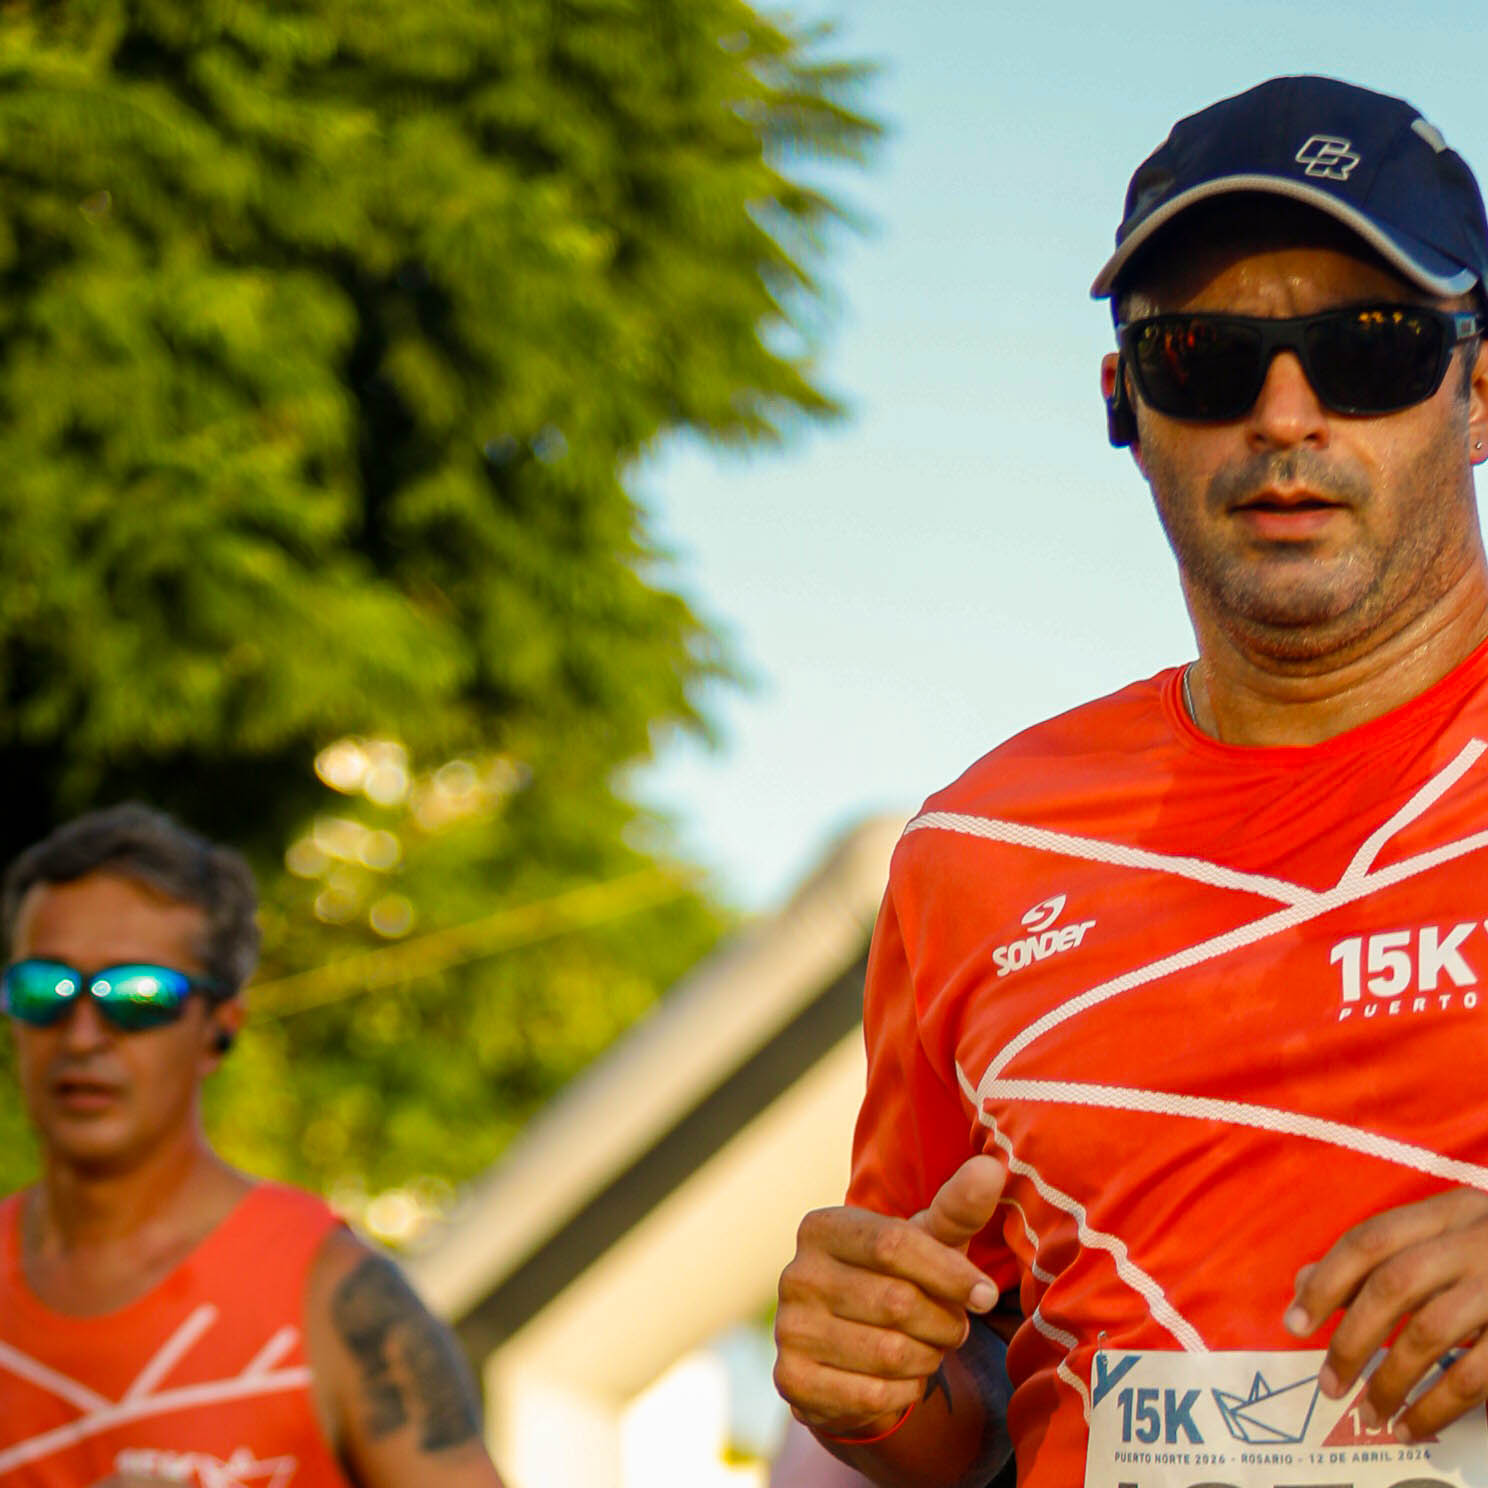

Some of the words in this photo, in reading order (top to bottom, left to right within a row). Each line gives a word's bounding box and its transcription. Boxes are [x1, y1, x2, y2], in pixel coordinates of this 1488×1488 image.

[1330, 922, 1478, 1003] 15K
[1338, 991, 1478, 1022] PUERTO
[1117, 1387, 1205, 1444] 15K
[1114, 1452, 1151, 1464] PUERTO
[1154, 1453, 1190, 1465] NORTE
[1241, 1454, 1293, 1464] ROSARIO
[1309, 1453, 1323, 1464] 12
[1329, 1453, 1346, 1464] DE
[1352, 1452, 1392, 1463] ABRIL
